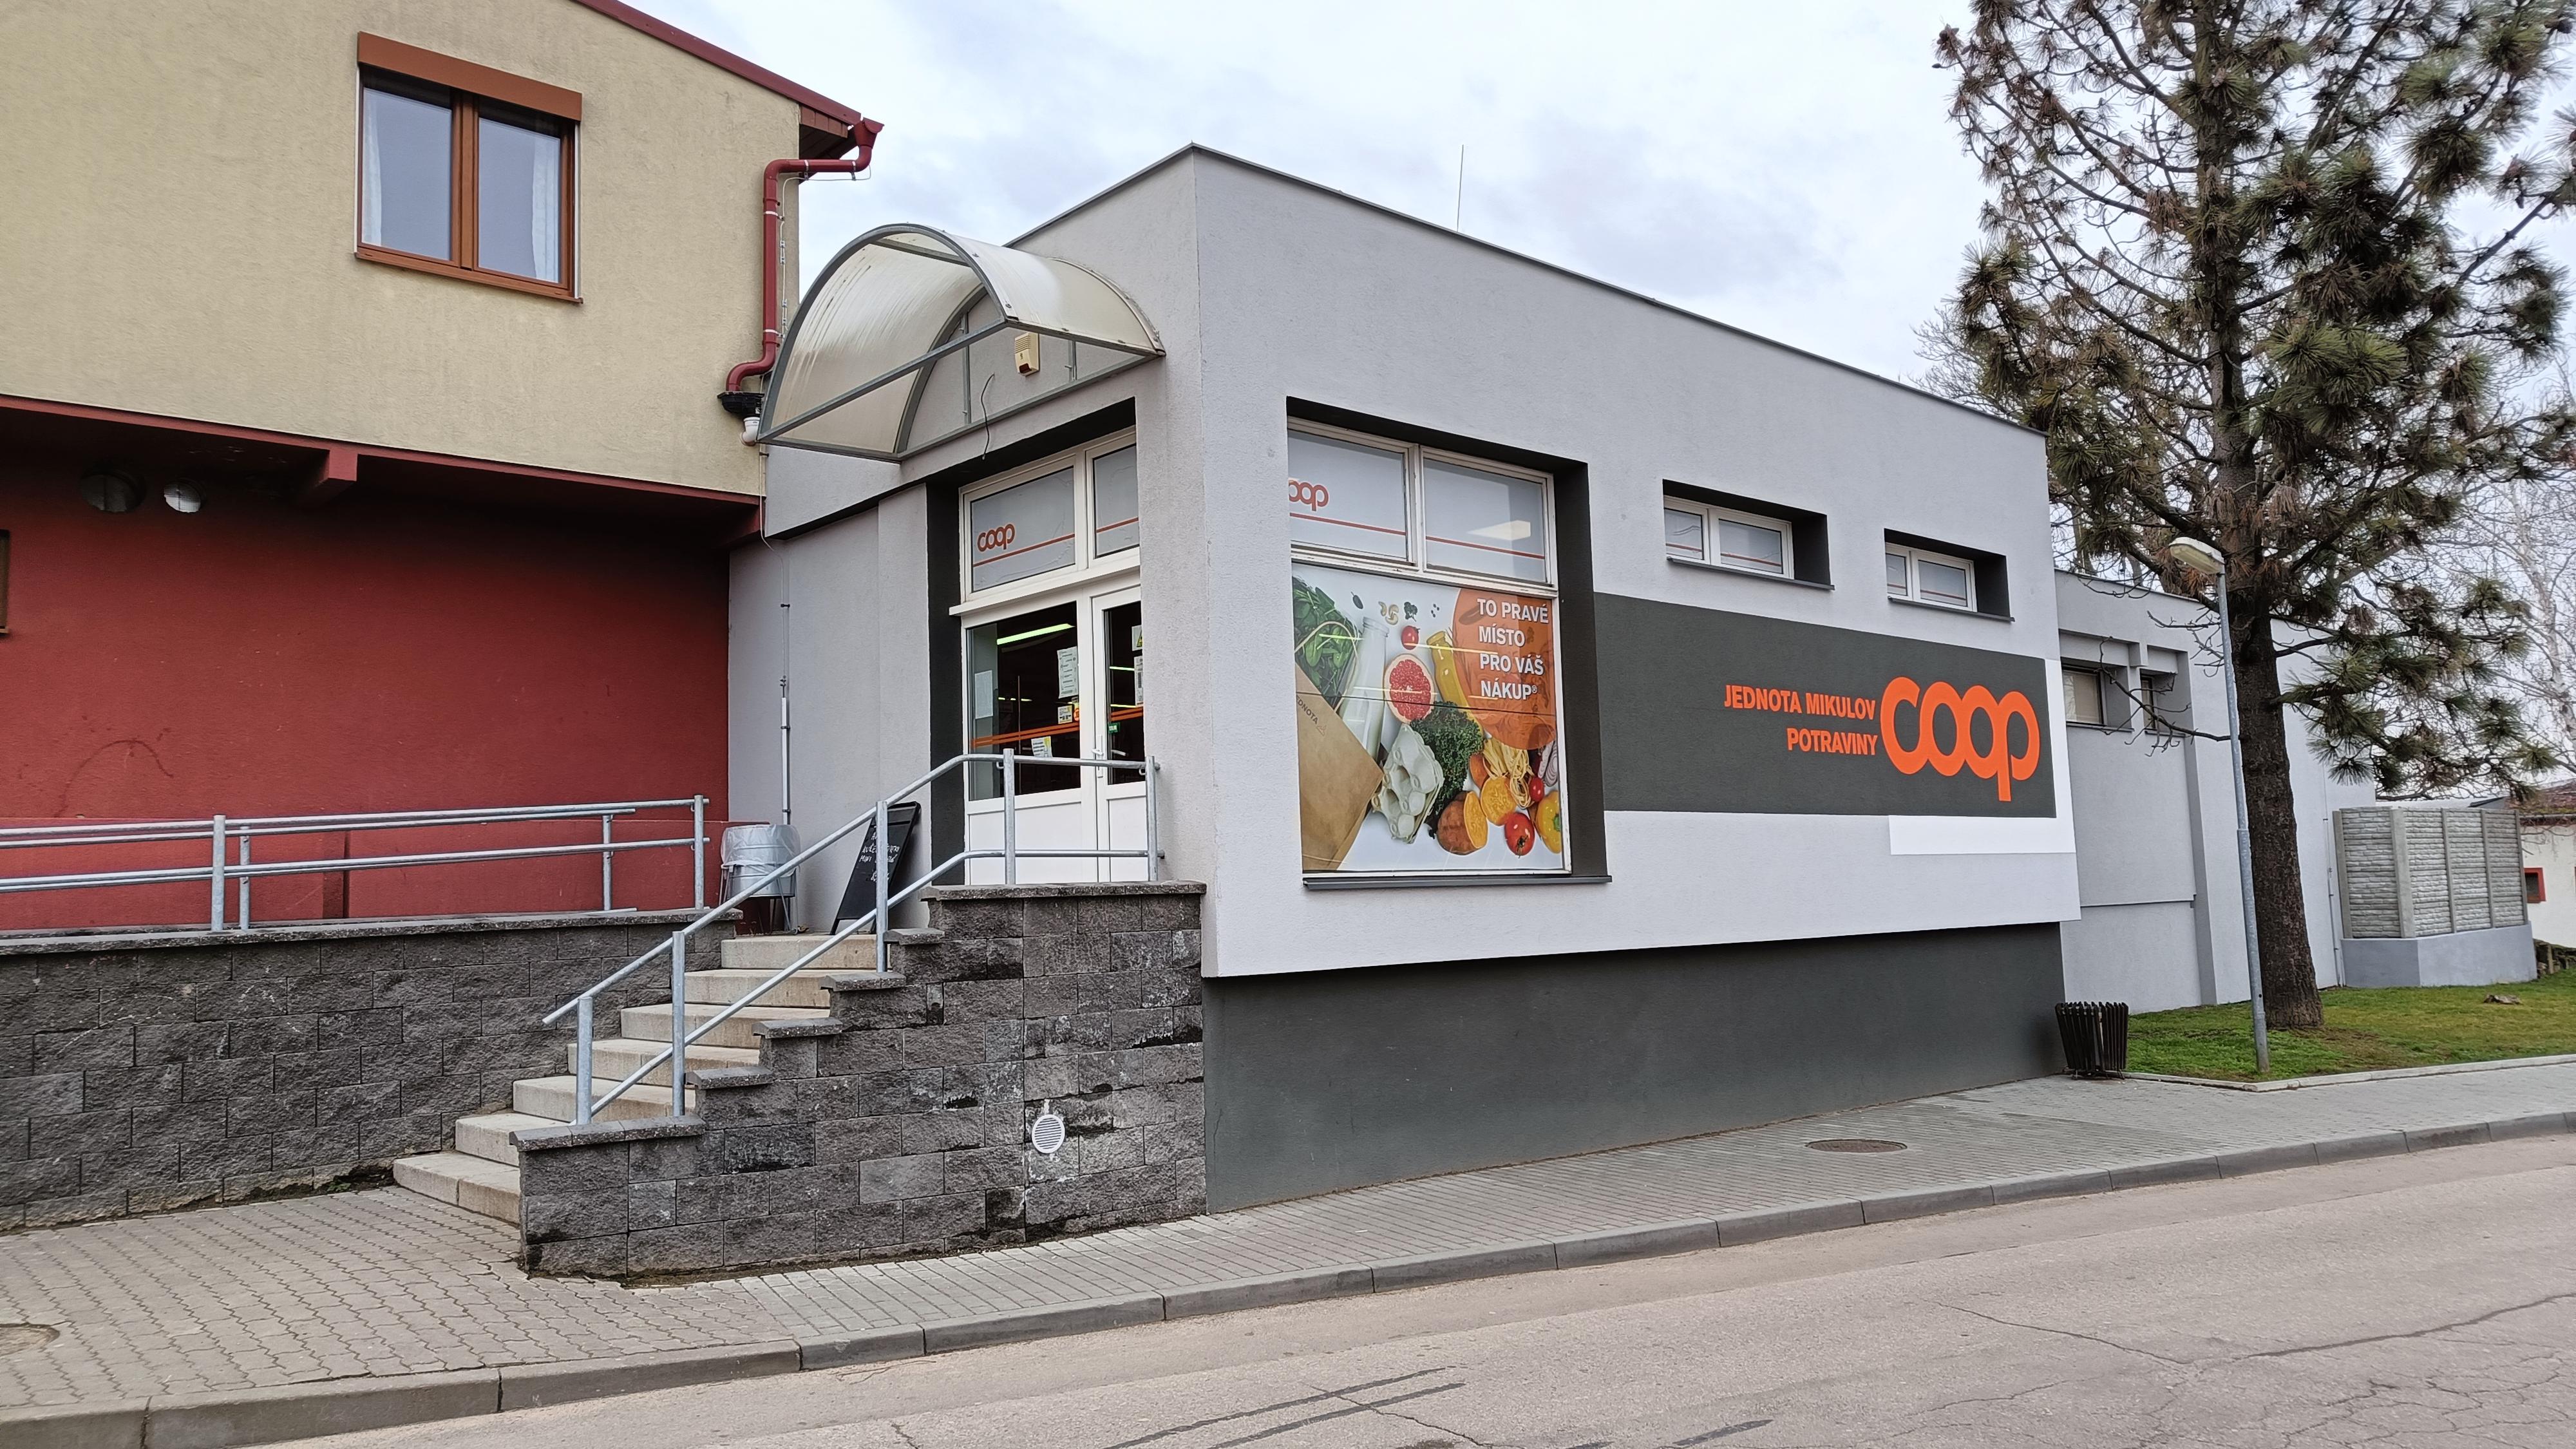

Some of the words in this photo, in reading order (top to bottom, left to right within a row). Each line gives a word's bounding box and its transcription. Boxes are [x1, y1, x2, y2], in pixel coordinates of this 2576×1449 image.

[978, 524, 1015, 552] coop
[1477, 598, 1497, 617] TO
[1502, 603, 1548, 623] PRAVÉ
[1479, 623, 1525, 647] MÍSTO
[1480, 653, 1511, 672] PRO
[1515, 654, 1544, 676] VÁŠ
[1724, 685, 1802, 714] JEDNOTA
[1806, 692, 1875, 720] MIKULOV
[1786, 728, 1878, 755] POTRAVINY
[1880, 676, 2040, 802] coop
